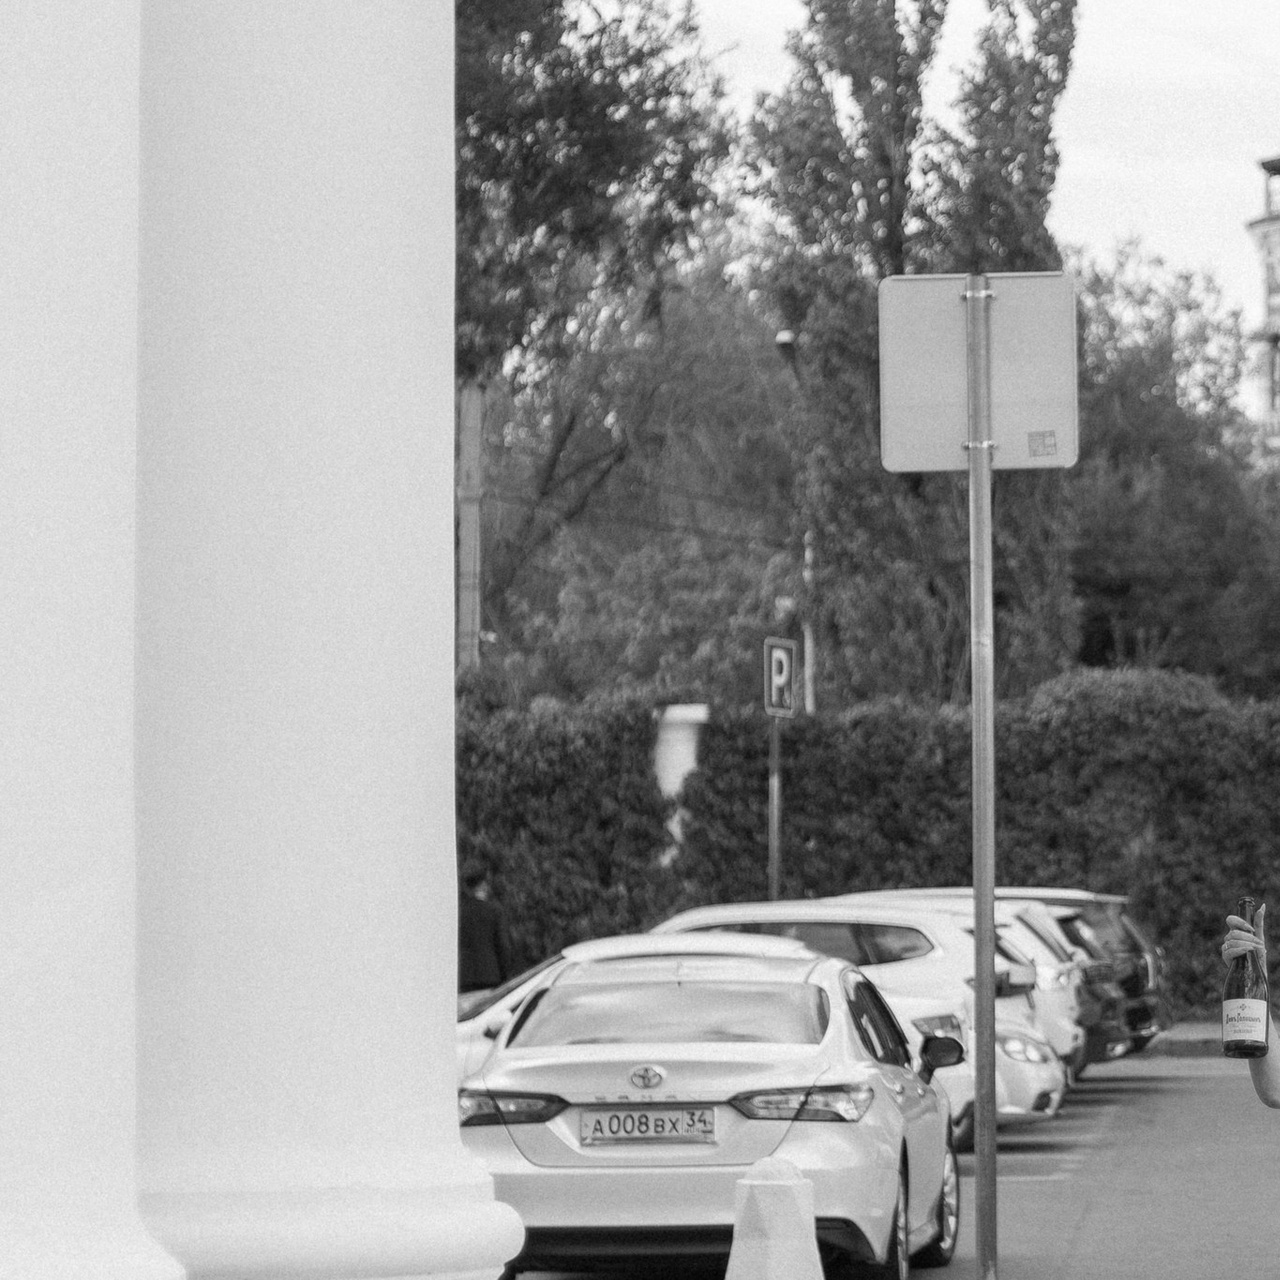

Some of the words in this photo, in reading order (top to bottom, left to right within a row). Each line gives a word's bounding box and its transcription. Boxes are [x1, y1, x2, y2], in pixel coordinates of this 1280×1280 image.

[771, 647, 791, 707] P
[592, 1113, 680, 1135] А008ВХ
[686, 1110, 708, 1128] 34
